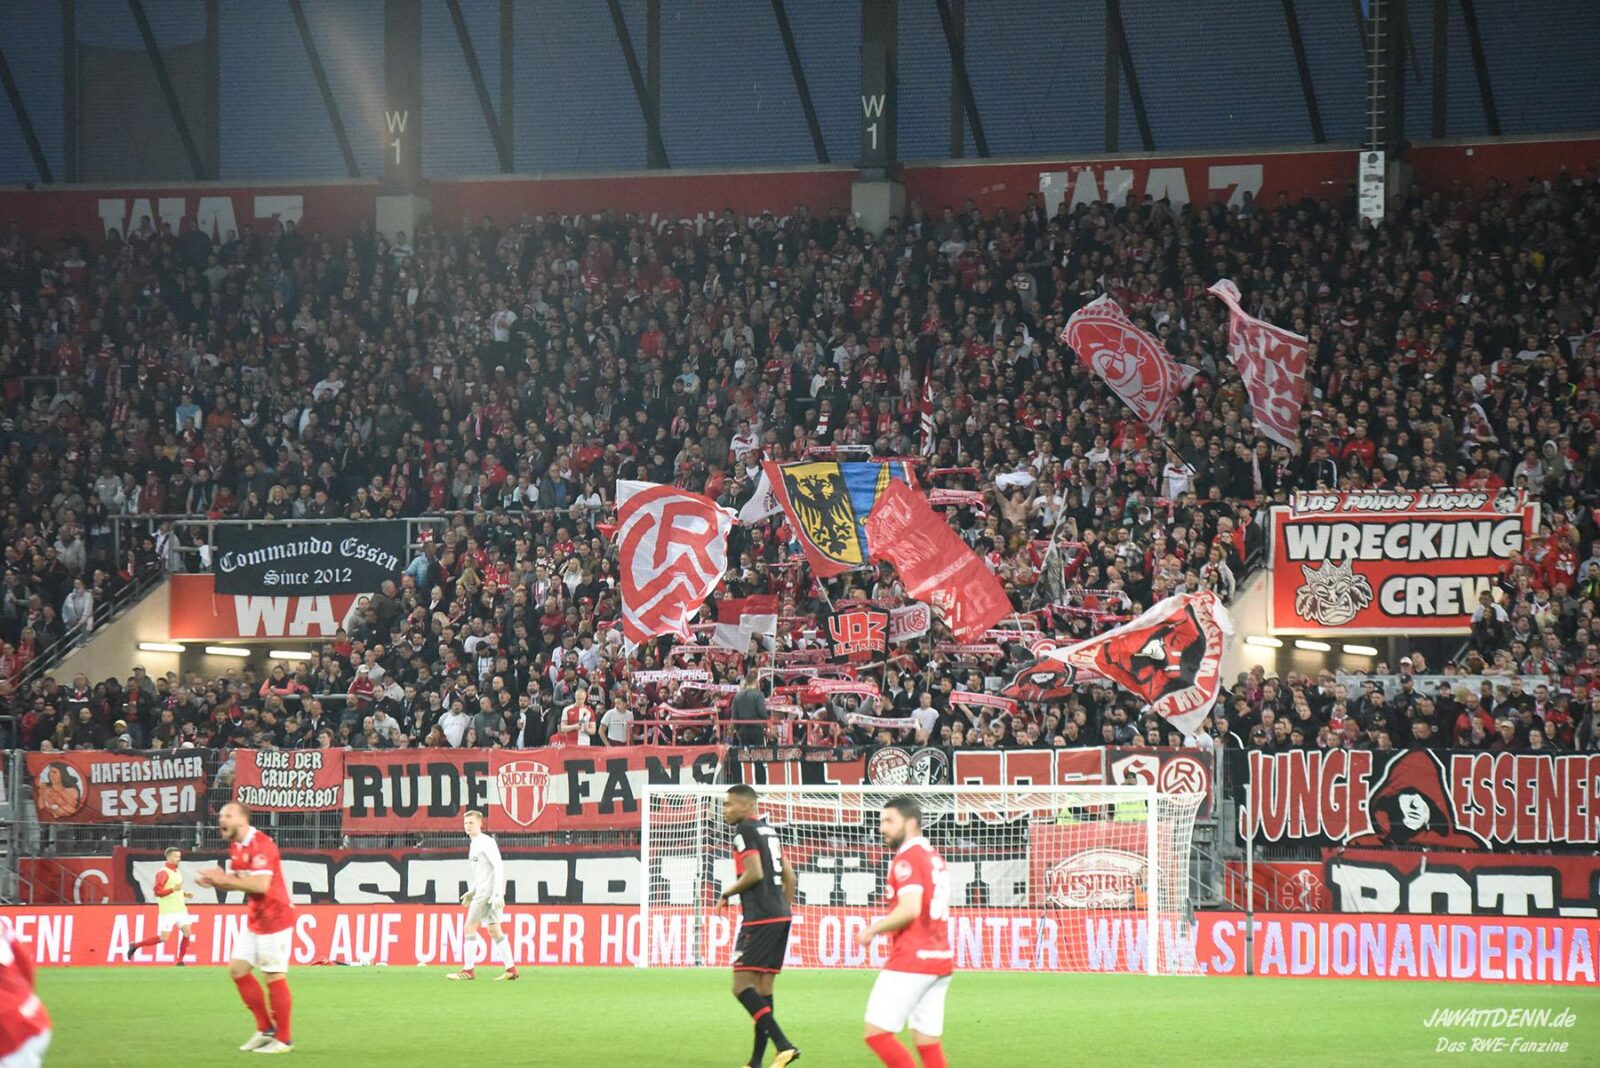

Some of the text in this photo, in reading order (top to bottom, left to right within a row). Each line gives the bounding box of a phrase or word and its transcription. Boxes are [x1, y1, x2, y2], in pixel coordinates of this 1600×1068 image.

[862, 95, 885, 117] W
[386, 111, 407, 133] W
[867, 123, 877, 149] 1
[391, 139, 400, 164] 1
[1285, 519, 1523, 560] WRECKING
[219, 536, 399, 573] Commando Essen
[263, 568, 352, 585] Since 2012
[91, 756, 202, 783] HAFENSÄNGER
[256, 751, 322, 769] EHRE DER
[261, 770, 314, 787] GRUPPE
[348, 762, 489, 818] RUDE
[102, 785, 196, 816] ESSEN
[1238, 749, 1374, 842] JUNGE
[107, 914, 200, 962] ALLE
[211, 914, 317, 964] INS
[330, 914, 402, 964] AUF
[947, 916, 1059, 969] NTER
[1085, 917, 1600, 983] WWW.STADIONANDERHA
